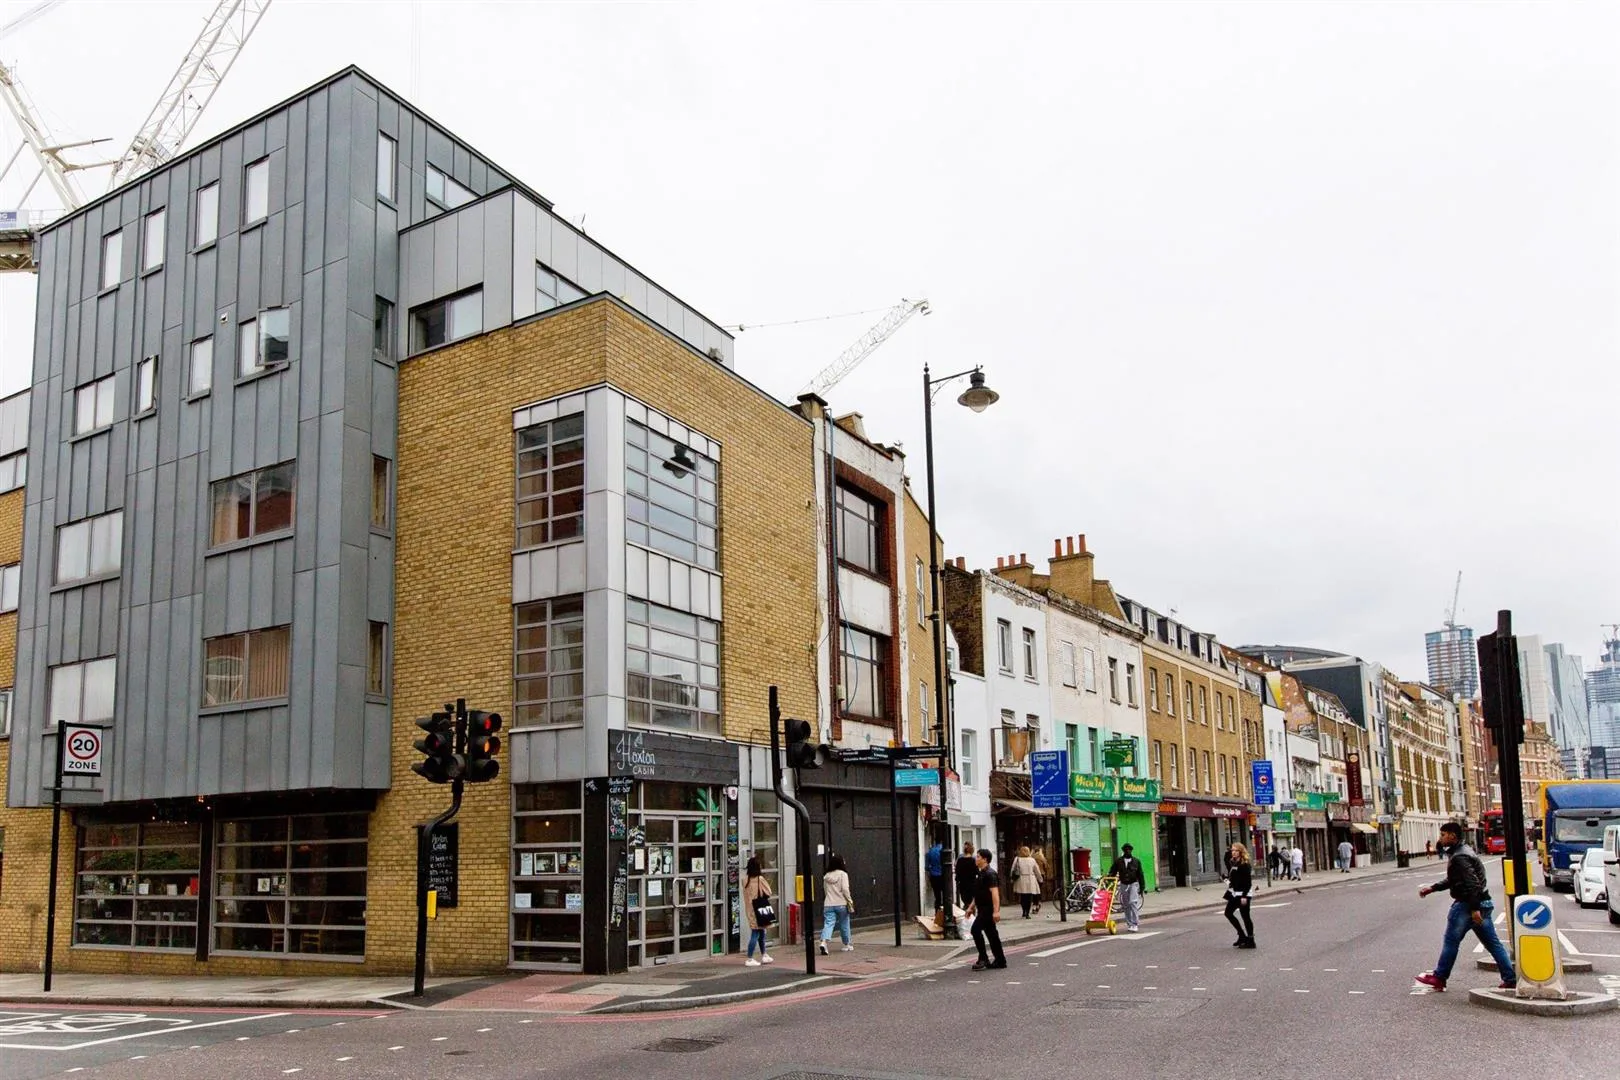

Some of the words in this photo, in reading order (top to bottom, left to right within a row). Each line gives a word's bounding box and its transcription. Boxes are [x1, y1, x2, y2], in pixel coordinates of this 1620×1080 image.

[73, 738, 95, 752] 20
[616, 733, 656, 770] Hoxton
[68, 760, 97, 770] ZONE
[632, 765, 655, 776] CABIN
